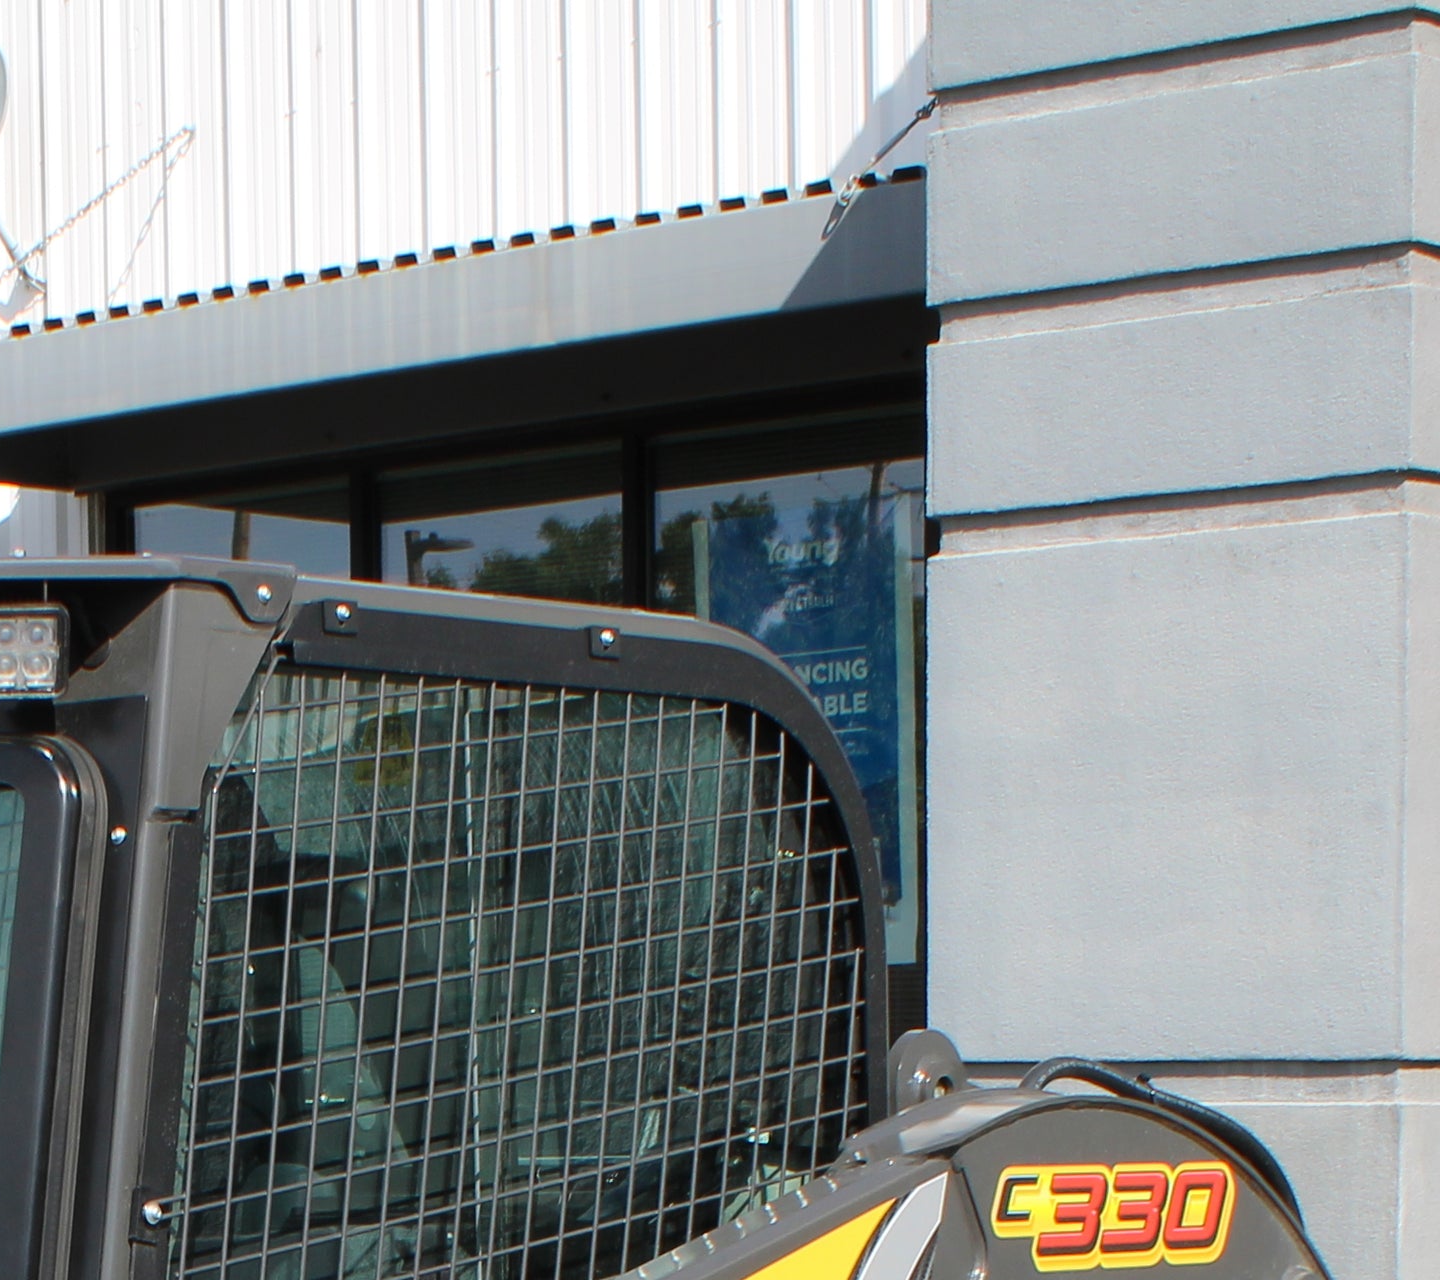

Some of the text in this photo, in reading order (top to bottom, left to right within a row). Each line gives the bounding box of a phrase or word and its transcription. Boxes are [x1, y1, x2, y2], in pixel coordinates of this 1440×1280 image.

[763, 538, 841, 567] Young
[794, 657, 869, 685] NCING
[815, 690, 869, 717] BLE
[995, 1166, 1231, 1262] C330
